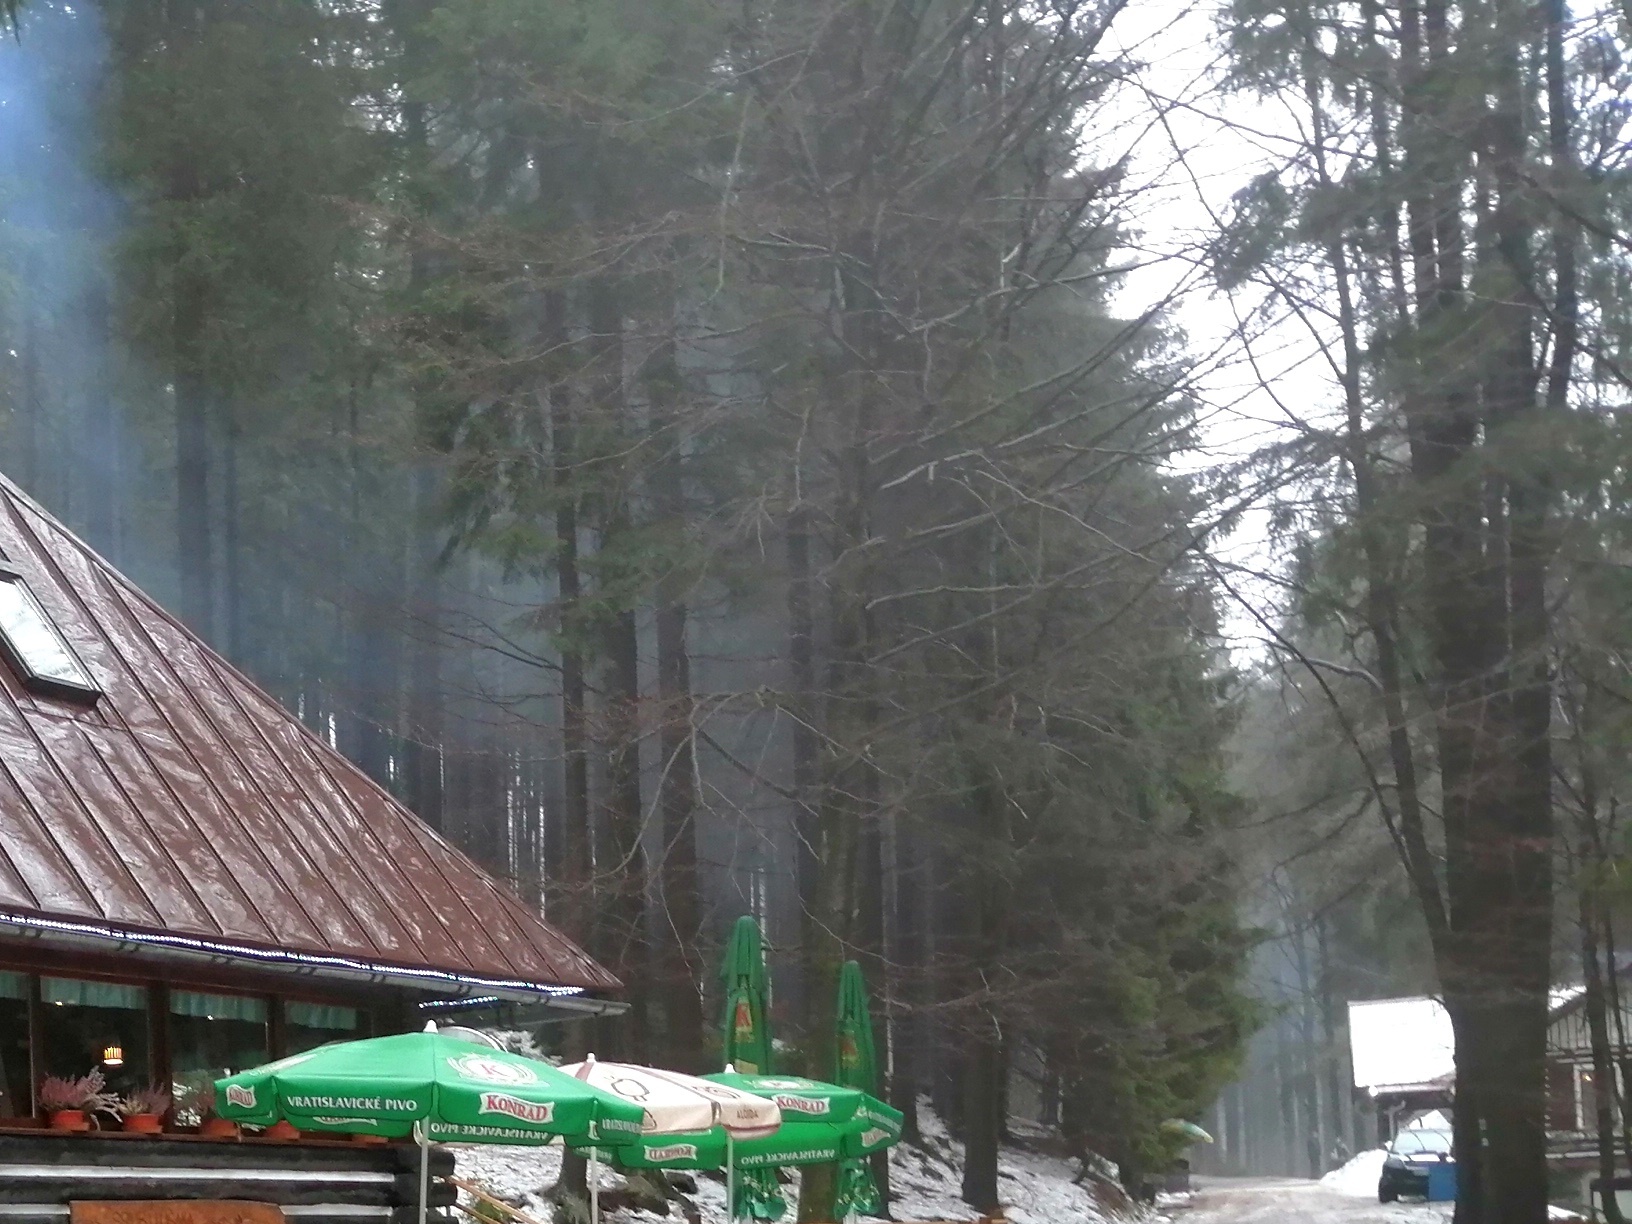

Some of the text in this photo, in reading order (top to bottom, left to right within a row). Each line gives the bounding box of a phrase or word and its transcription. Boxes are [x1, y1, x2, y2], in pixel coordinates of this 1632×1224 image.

[287, 1096, 418, 1112] VRATISLAVICKÉ PIVO
[487, 1094, 549, 1121] KONRAD
[778, 1096, 825, 1114] KONRAD
